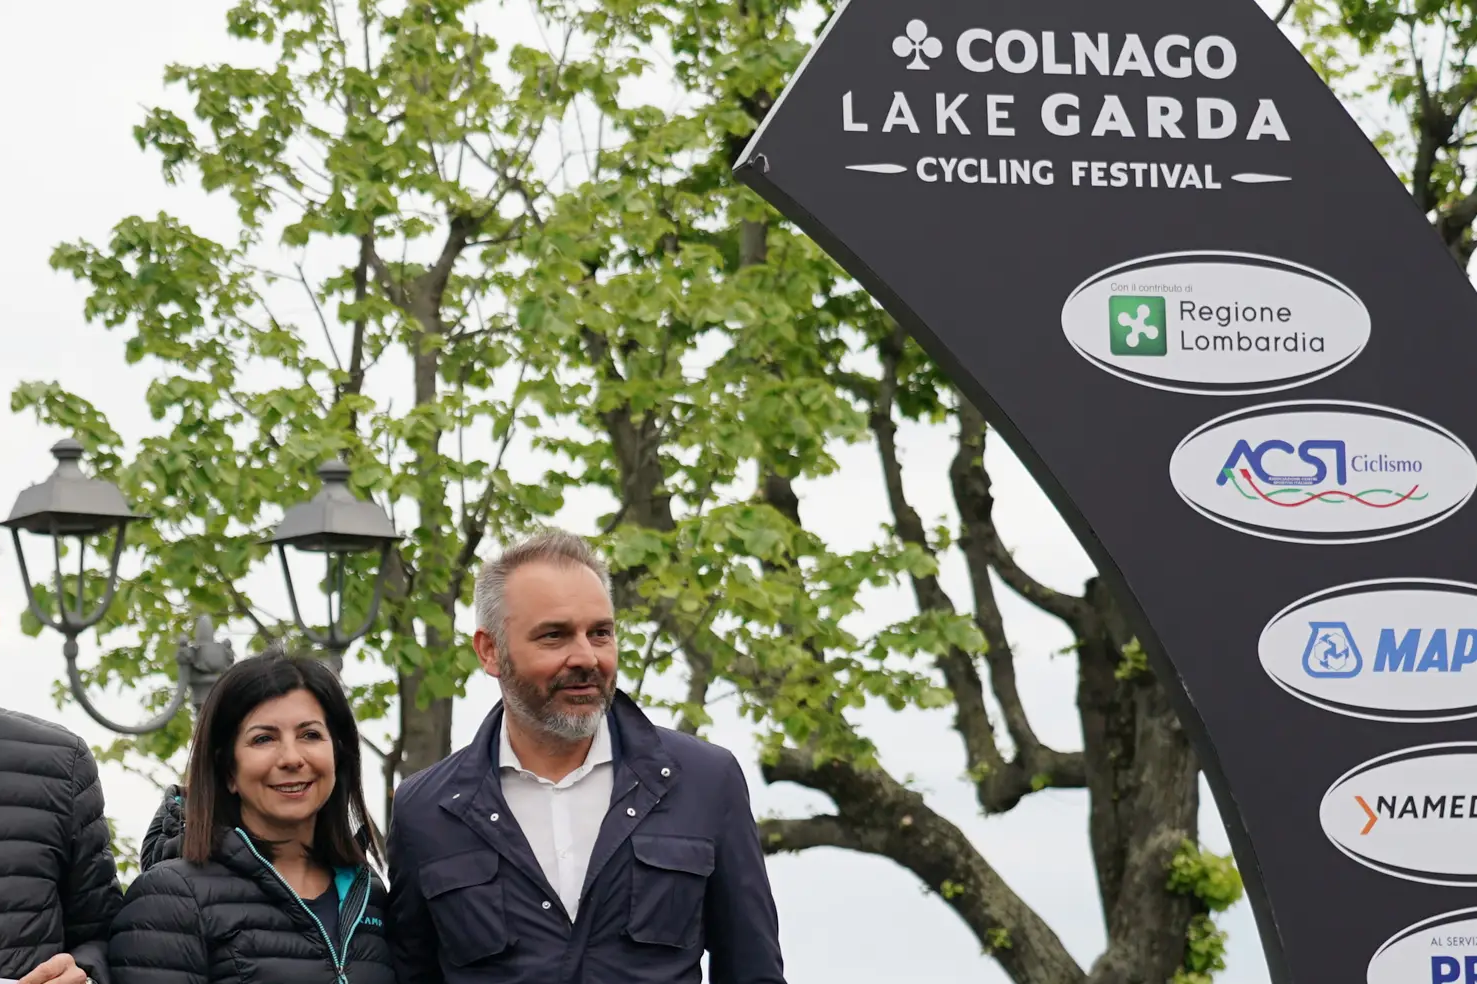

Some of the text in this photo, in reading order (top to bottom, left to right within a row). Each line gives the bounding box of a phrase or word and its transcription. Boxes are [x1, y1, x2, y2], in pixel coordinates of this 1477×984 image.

[955, 27, 1238, 80] COLNAGO
[841, 90, 1292, 142] LAKE GARDA
[915, 156, 1223, 190] CYCLING FESTIVAL
[1110, 282, 1193, 293] Con il contributo di
[1179, 300, 1292, 327] Regione
[1180, 330, 1325, 353] Lombardia
[1215, 439, 1423, 486] ACSI Ciclismo
[1430, 936, 1445, 946] AL
